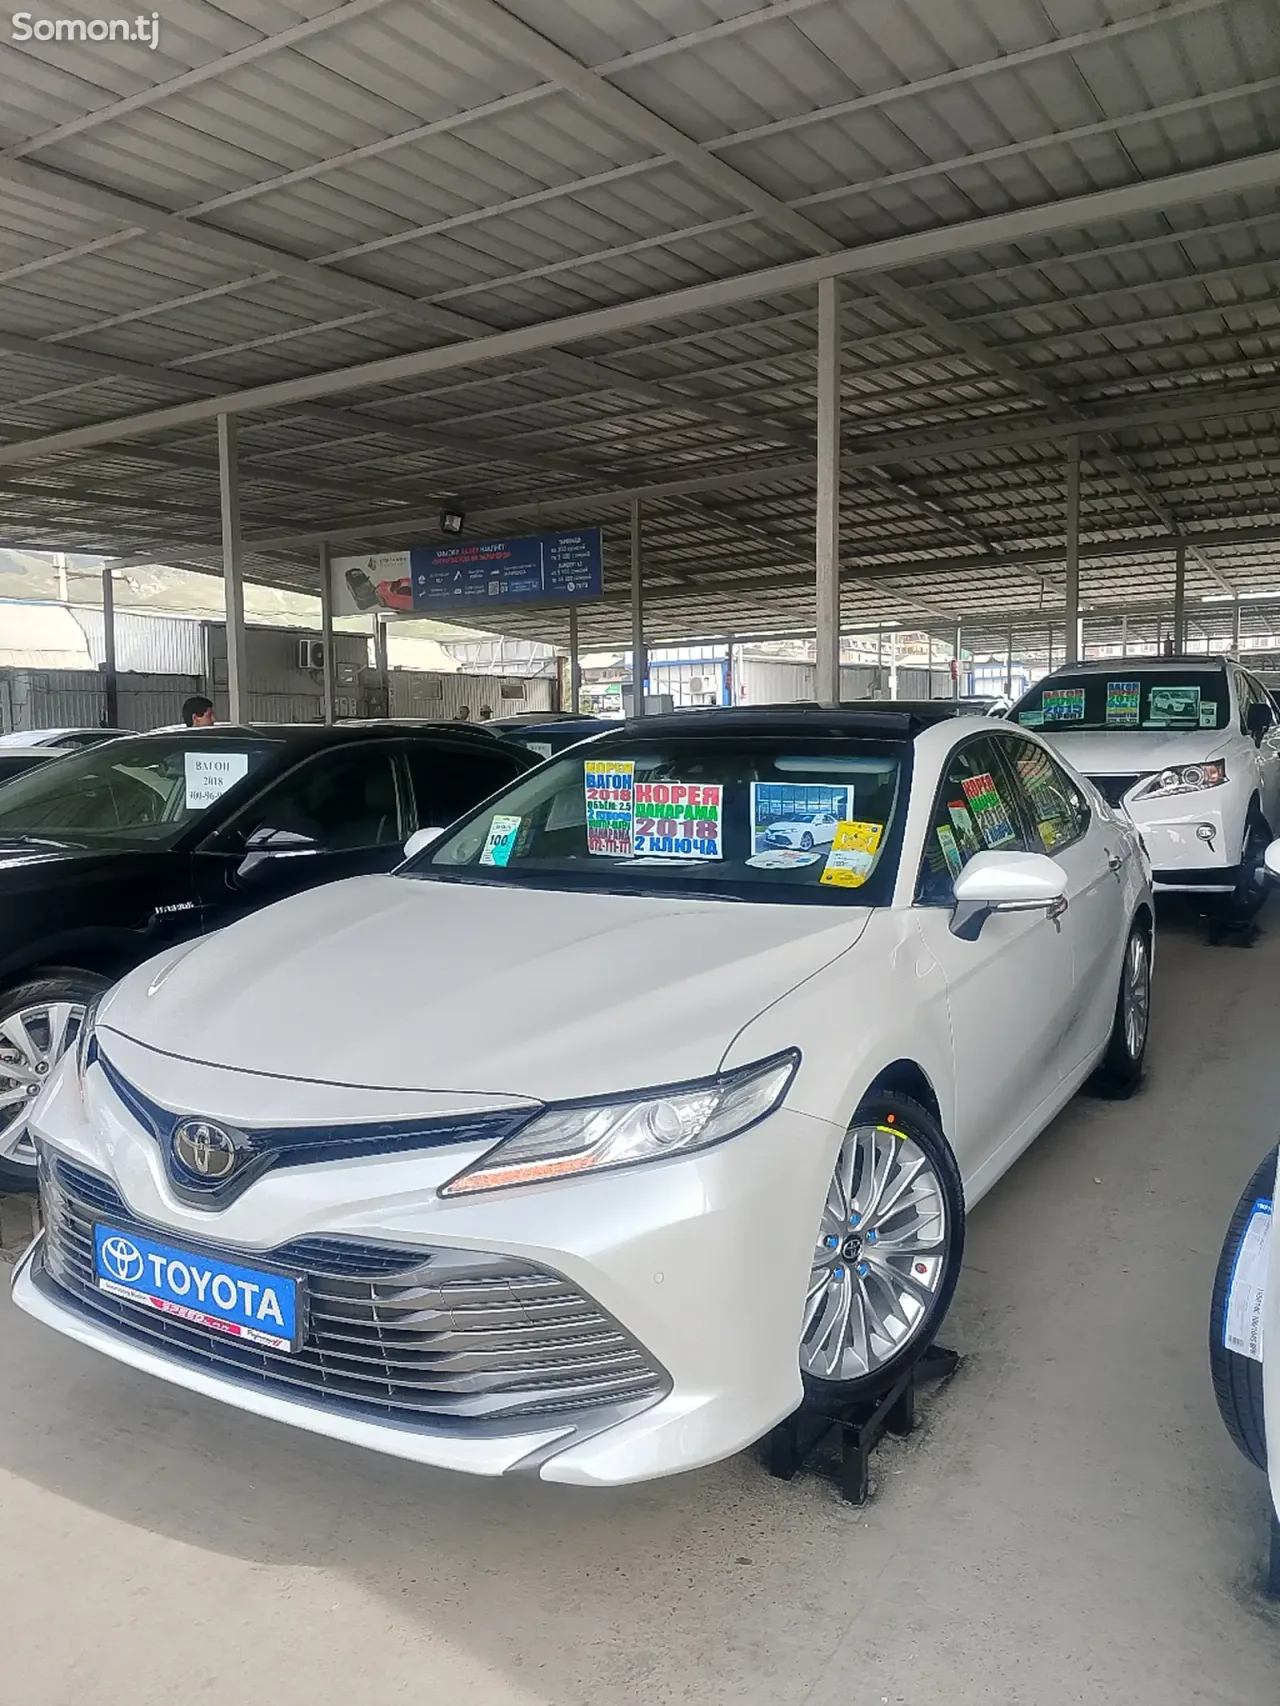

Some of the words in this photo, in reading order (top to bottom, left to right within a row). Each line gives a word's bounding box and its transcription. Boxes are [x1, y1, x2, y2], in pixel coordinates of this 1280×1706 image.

[204, 777, 223, 785] 2018
[586, 774, 632, 789] ВАГОН
[587, 789, 631, 801] 2018
[636, 784, 720, 806] КОРЕЯ
[635, 803, 719, 821] ПАНАРАМА
[636, 818, 719, 839] 2018
[489, 834, 509, 846] 100
[635, 836, 646, 851] 2
[650, 837, 719, 855] КЛЮЧА
[148, 1253, 285, 1327] TOYOTA
